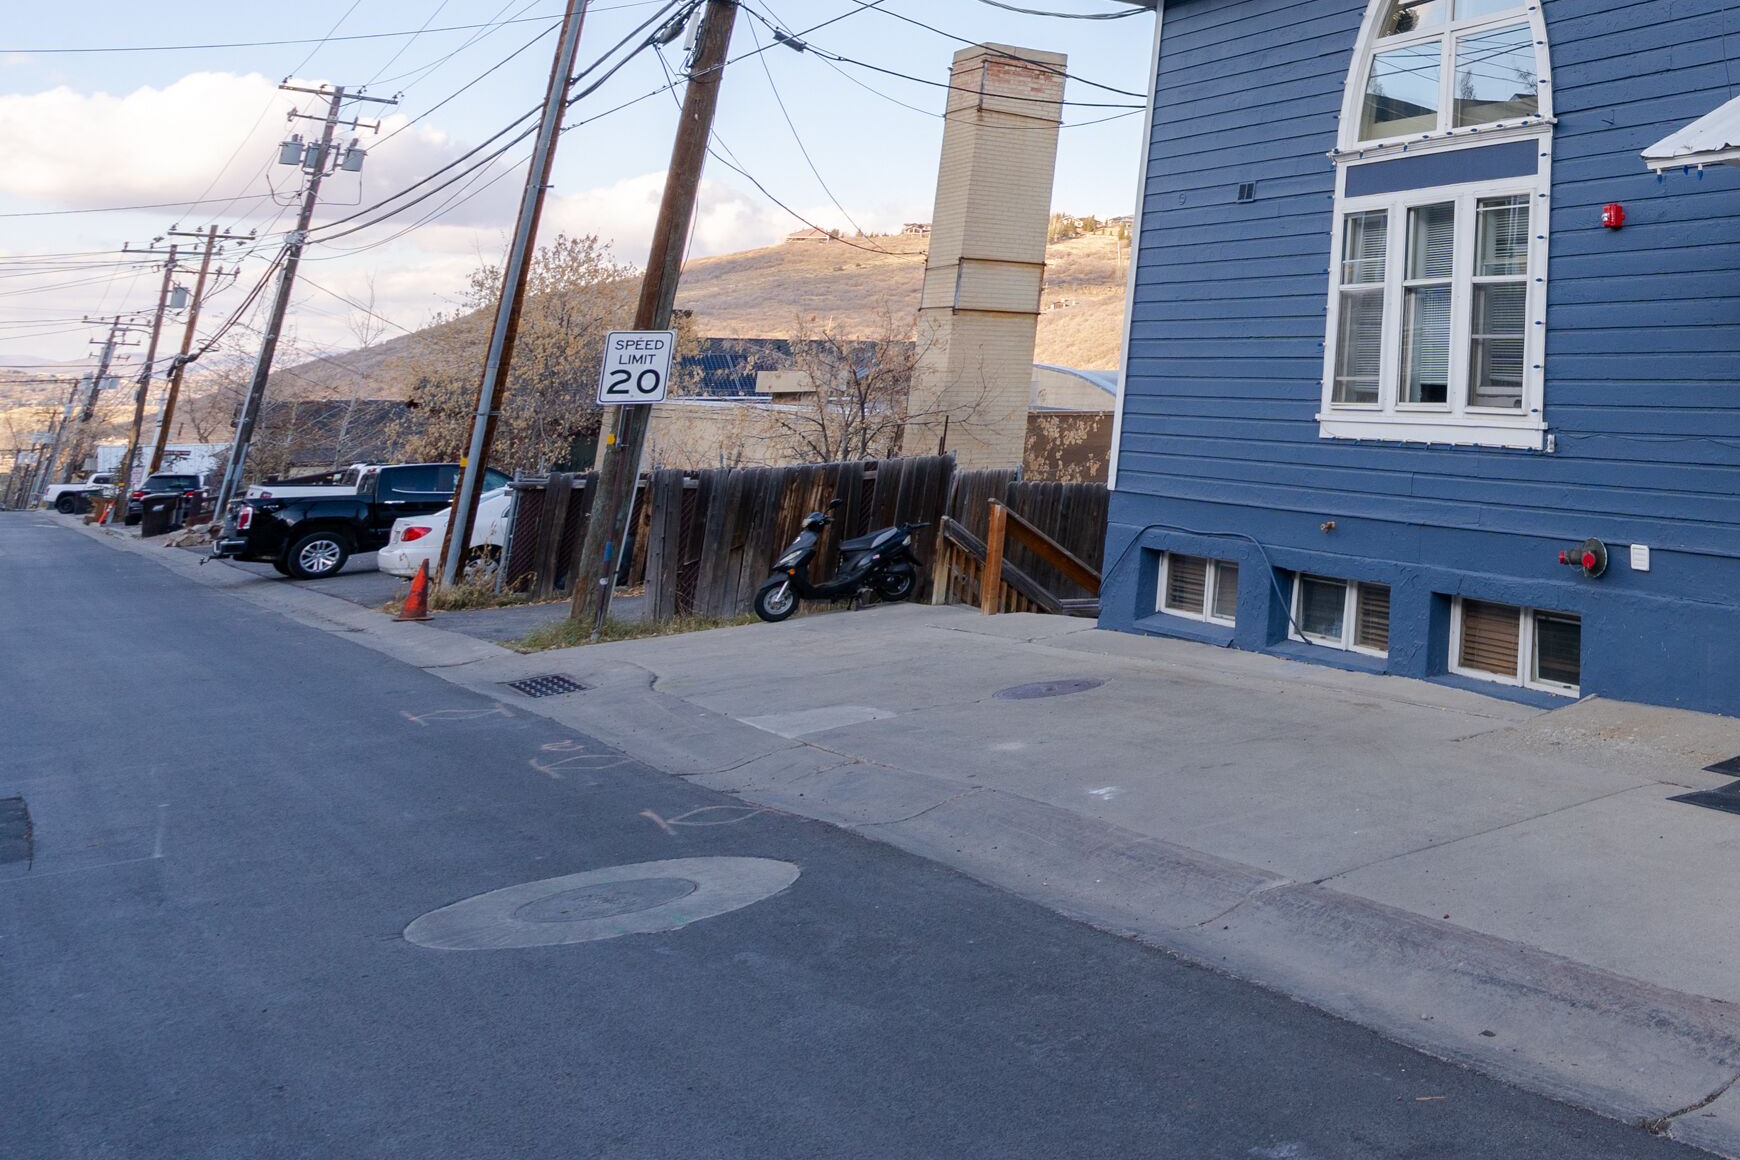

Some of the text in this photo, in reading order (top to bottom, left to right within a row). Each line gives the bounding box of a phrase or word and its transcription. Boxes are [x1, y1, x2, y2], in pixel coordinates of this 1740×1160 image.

[615, 339, 664, 351] SPEED
[618, 354, 656, 365] LIMIT
[606, 369, 661, 395] 20
